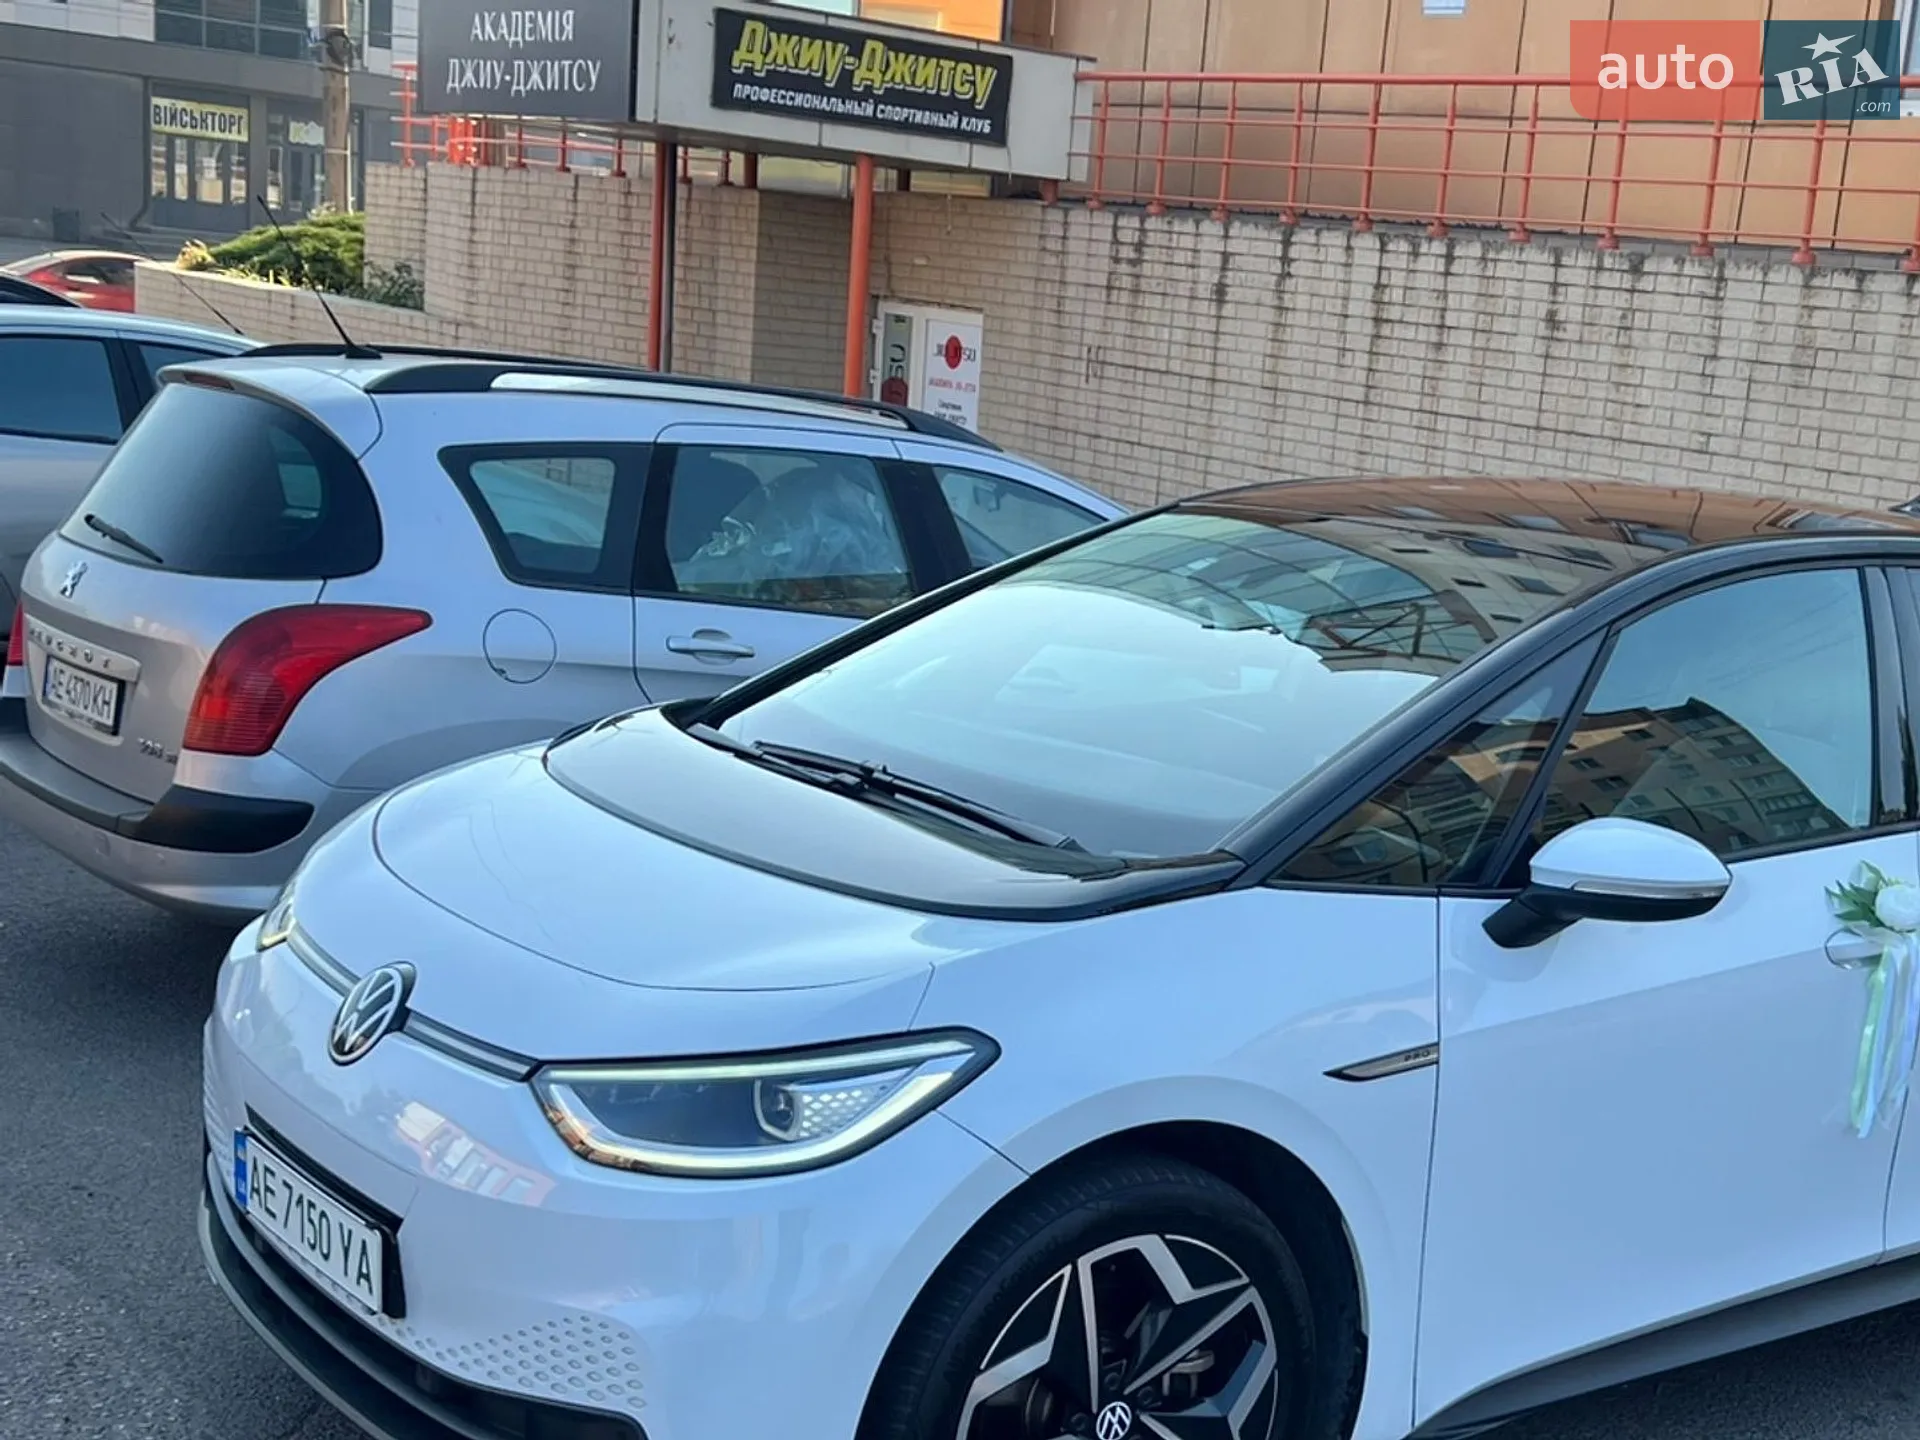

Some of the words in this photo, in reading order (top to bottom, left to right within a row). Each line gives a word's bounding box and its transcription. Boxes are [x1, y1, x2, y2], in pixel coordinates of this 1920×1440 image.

[470, 10, 575, 48] АКАДЕМІЯ
[153, 103, 243, 135] ВІЙСЬКТОРГ
[733, 83, 873, 118] ПРОФЕССИОНАЛЬНЫЙ
[876, 104, 959, 130] СПОРТИВНЫЙ
[960, 117, 992, 134] КЛУБ
[91, 682, 113, 719] KH
[250, 1155, 277, 1221] AE
[282, 1179, 331, 1262] 7150
[338, 1222, 374, 1296] YA
